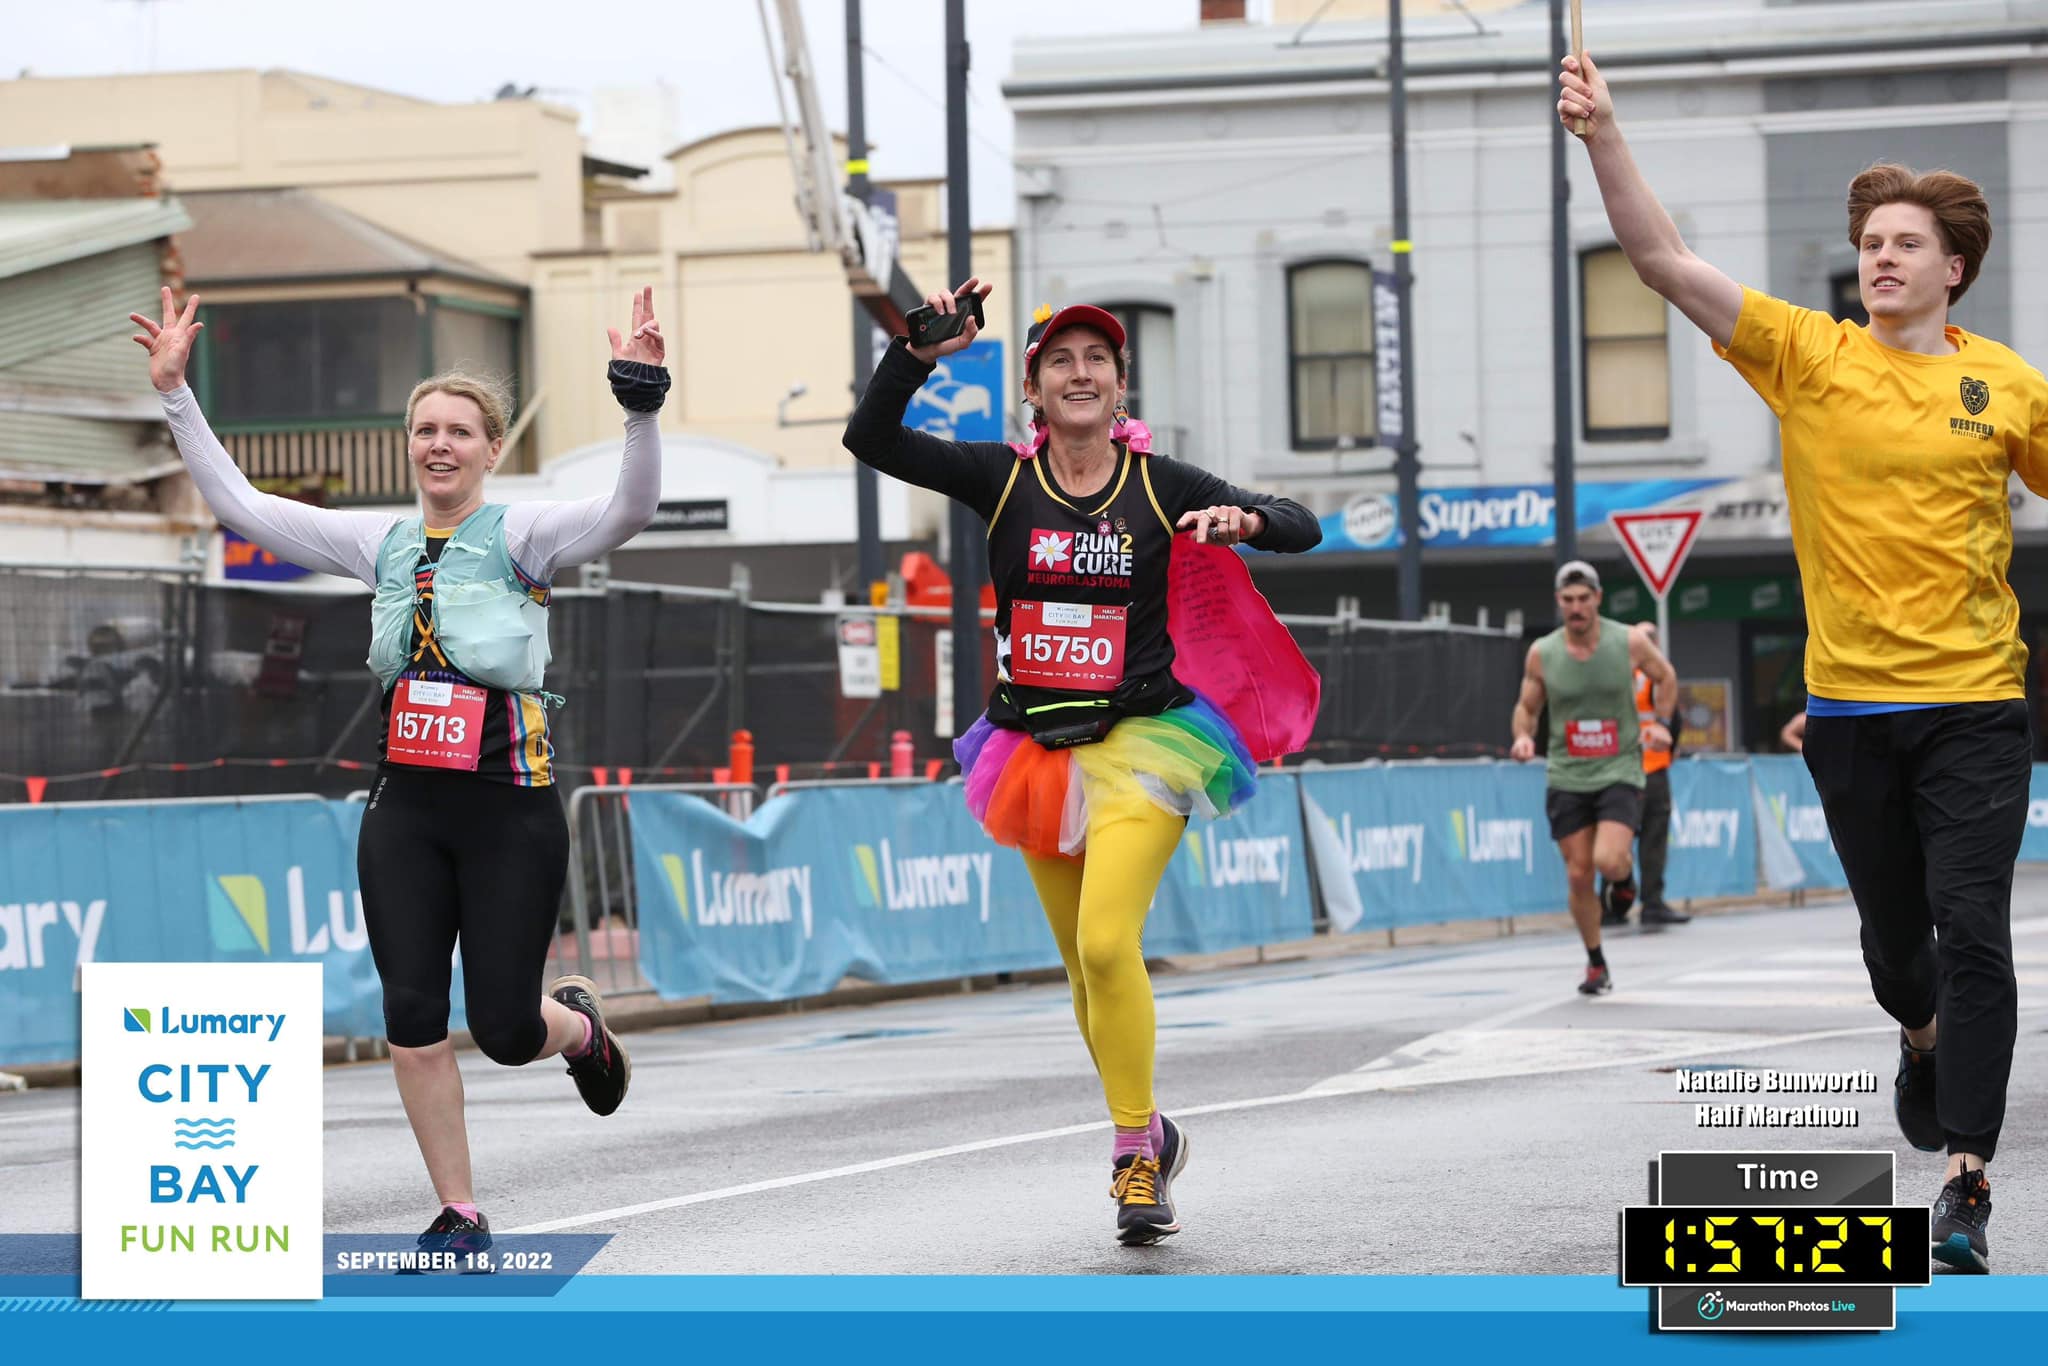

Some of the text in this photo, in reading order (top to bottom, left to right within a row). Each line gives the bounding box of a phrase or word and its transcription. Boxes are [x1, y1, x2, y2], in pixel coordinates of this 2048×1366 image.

[1950, 417, 1994, 436] WESTERN
[1418, 489, 1556, 540] SuperDr
[1710, 502, 1783, 519] JETTY
[1639, 526, 1673, 537] GIVE
[1027, 573, 1131, 589] NEUROBLASTOMA
[1073, 553, 1132, 576] CURE
[1021, 633, 1113, 666] 15750
[453, 694, 484, 702] MARATHON
[396, 711, 466, 744] 15713
[1467, 804, 1533, 875] Lumary
[1206, 824, 1289, 898] Lumary
[692, 849, 812, 940] Lumary
[881, 838, 992, 923] Lumary
